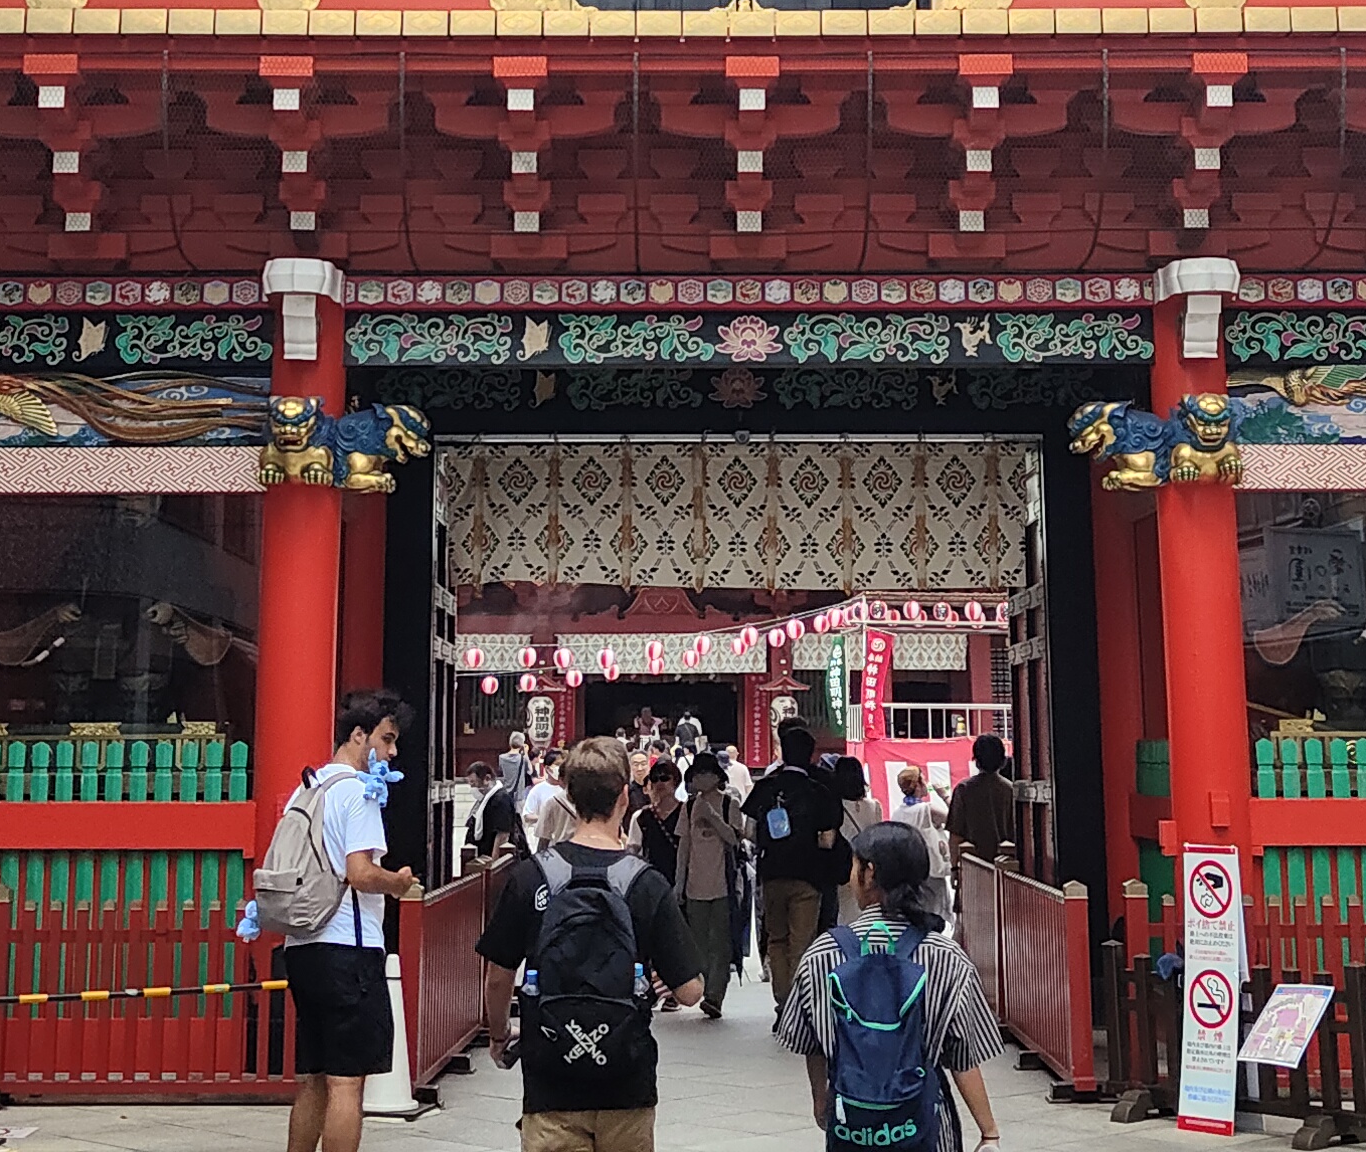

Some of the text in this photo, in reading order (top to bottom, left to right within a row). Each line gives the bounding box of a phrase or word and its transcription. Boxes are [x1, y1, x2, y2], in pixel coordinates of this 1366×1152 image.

[829, 667, 843, 709] 神田明神
[1187, 918, 1236, 932] ポイ捨て禁止
[563, 1023, 610, 1064] KENZO
[565, 1019, 607, 1066] KENZO
[1198, 1029, 1223, 1042] 禁煙
[834, 1118, 917, 1146] adidas
